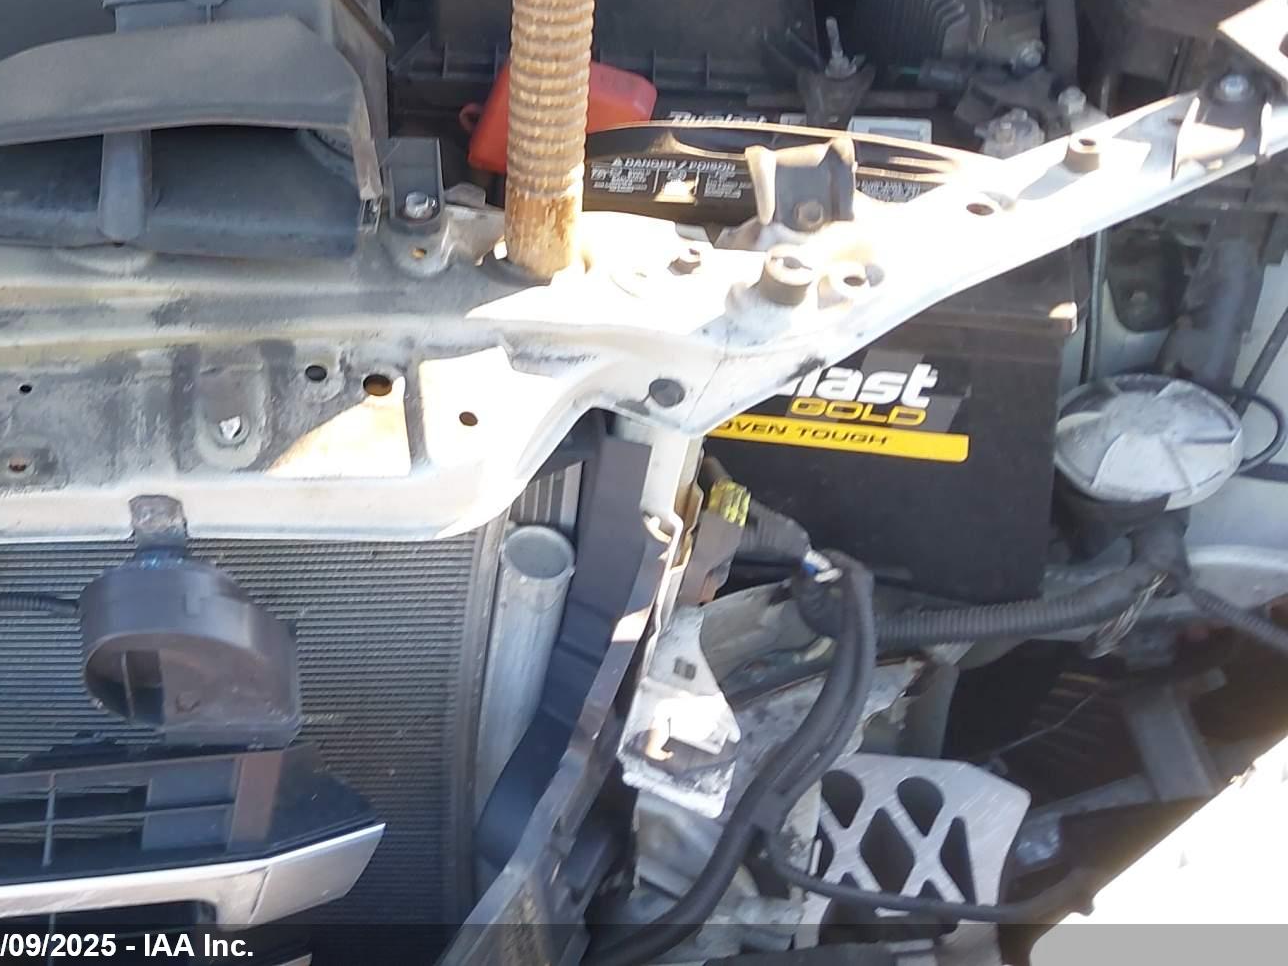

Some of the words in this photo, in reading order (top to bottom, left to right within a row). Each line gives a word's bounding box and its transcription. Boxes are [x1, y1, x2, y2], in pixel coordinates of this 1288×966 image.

[791, 398, 927, 425] GOLD
[716, 420, 788, 436] OVEN
[796, 427, 888, 445] TOUGH
